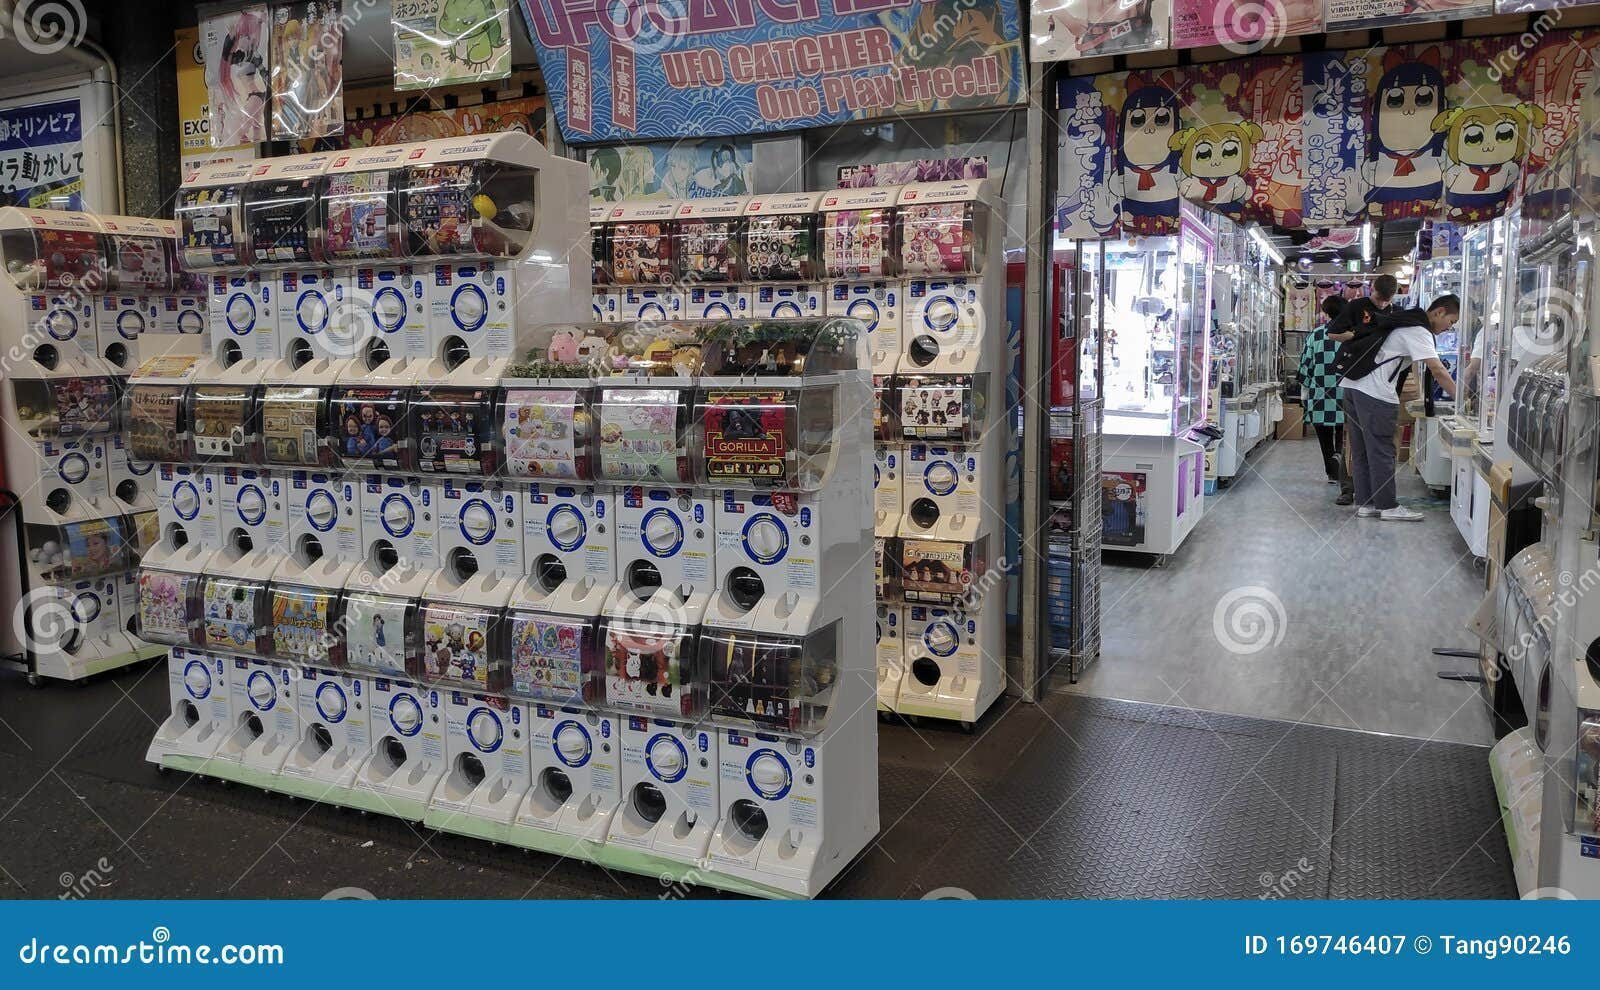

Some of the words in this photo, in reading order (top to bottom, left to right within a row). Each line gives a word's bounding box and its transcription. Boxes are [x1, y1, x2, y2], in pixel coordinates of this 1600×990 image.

[662, 48, 724, 89] UFO
[727, 27, 895, 84] CATCHER
[757, 83, 821, 121] One
[822, 74, 896, 113] Play
[898, 55, 1001, 103] Free!!
[719, 442, 769, 452] GORILLA
